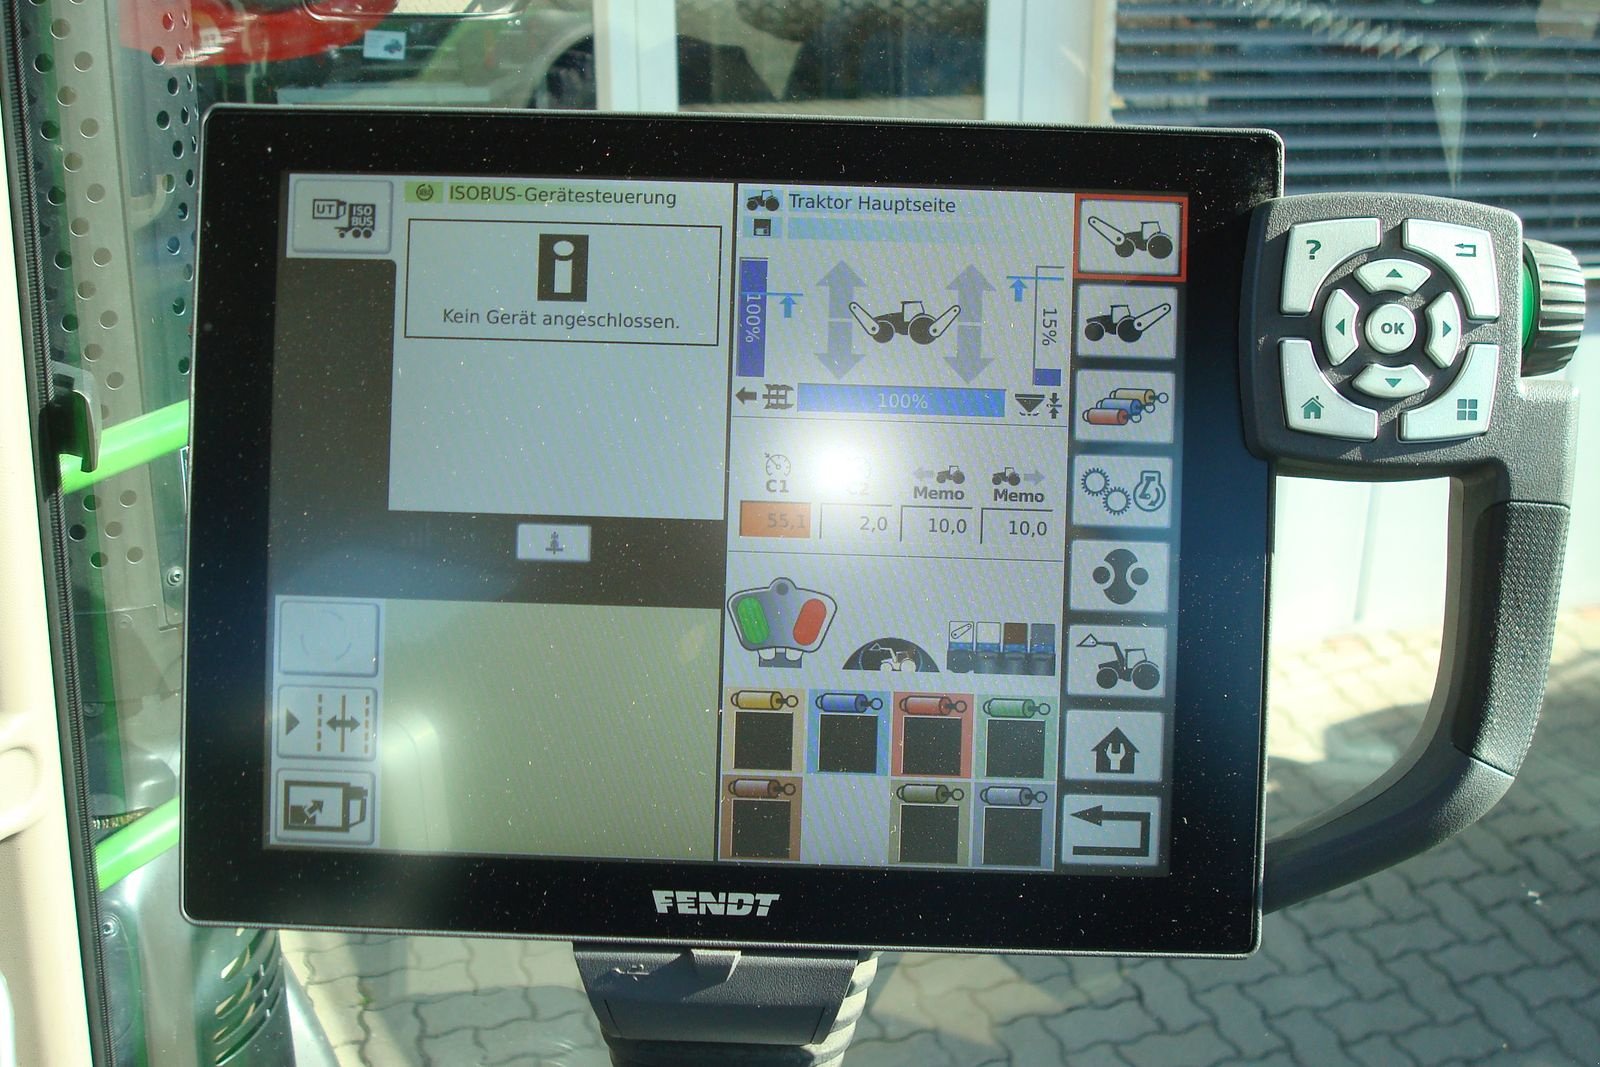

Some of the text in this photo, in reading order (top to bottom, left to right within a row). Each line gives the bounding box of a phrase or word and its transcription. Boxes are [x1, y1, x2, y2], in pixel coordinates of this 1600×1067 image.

[449, 185, 677, 208] ISOBUS-Gerätesteuerung
[789, 193, 956, 214] Traktor Hauptseite
[316, 203, 334, 215] UT
[352, 205, 372, 216] ISO
[351, 216, 373, 227] BUS
[442, 309, 680, 330] Kein Gerät angeschlossen.
[745, 293, 761, 344] 100%
[1042, 307, 1058, 346] 15%
[1380, 321, 1405, 335] OK
[877, 392, 928, 410] 100%
[766, 479, 789, 494] C1
[913, 487, 965, 502] Memo
[993, 490, 1044, 504] Memo
[767, 512, 806, 531] 55,1
[859, 515, 888, 533] 2,0
[927, 517, 967, 535] 10,0
[1009, 520, 1048, 537] 10,0
[652, 890, 780, 917] FENDT
